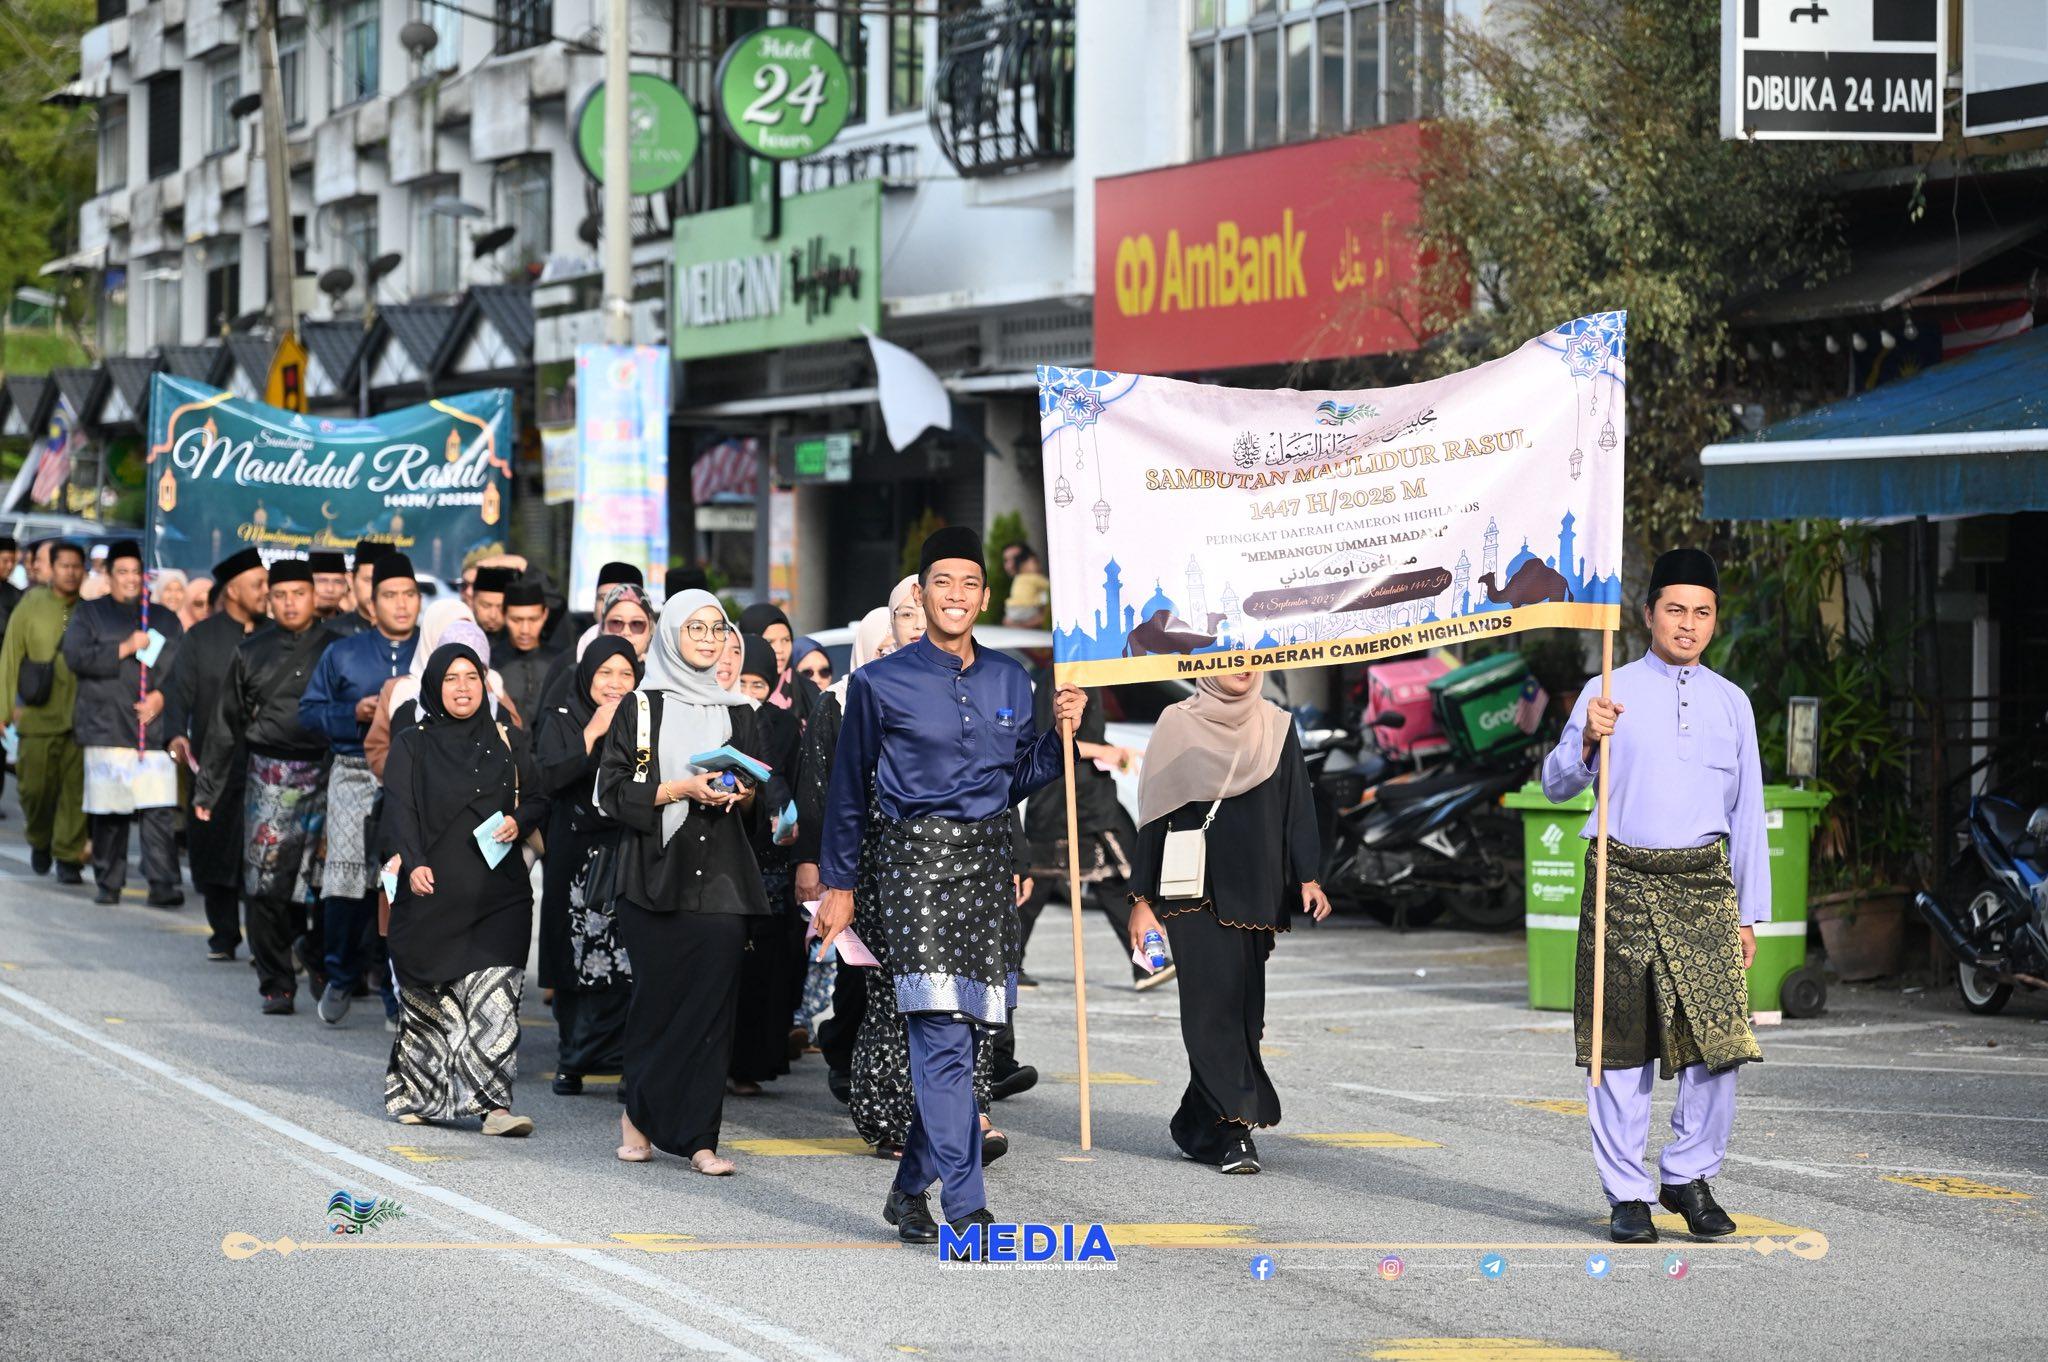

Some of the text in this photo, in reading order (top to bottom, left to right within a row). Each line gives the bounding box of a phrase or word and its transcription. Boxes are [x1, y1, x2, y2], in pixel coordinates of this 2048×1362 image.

[757, 34, 816, 59] Hotel
[742, 63, 827, 124] 24
[1746, 75, 1933, 113] DIBUKA 24 JAM
[758, 126, 814, 149] hours
[1160, 208, 1307, 313] AmBank
[172, 427, 366, 490] Maulidul
[367, 444, 490, 493] Rasul
[1145, 468, 1290, 491] SAMBUTAN
[1292, 444, 1440, 483] MAULIDUR
[1443, 428, 1533, 462] RASUL
[1250, 477, 1428, 520] 1447 H/2025 M
[1206, 530, 1278, 546] PERINGKAT
[1281, 523, 1334, 540] DAERAH
[1337, 513, 1401, 533] CAMERON
[1336, 534, 1388, 552] UMMAH
[1252, 601, 1264, 611] 24
[1266, 597, 1308, 612] September
[1311, 593, 1335, 605] 2025
[1177, 615, 1513, 673] MAJLIS DAERAH CAMERON HIGHLANDS
